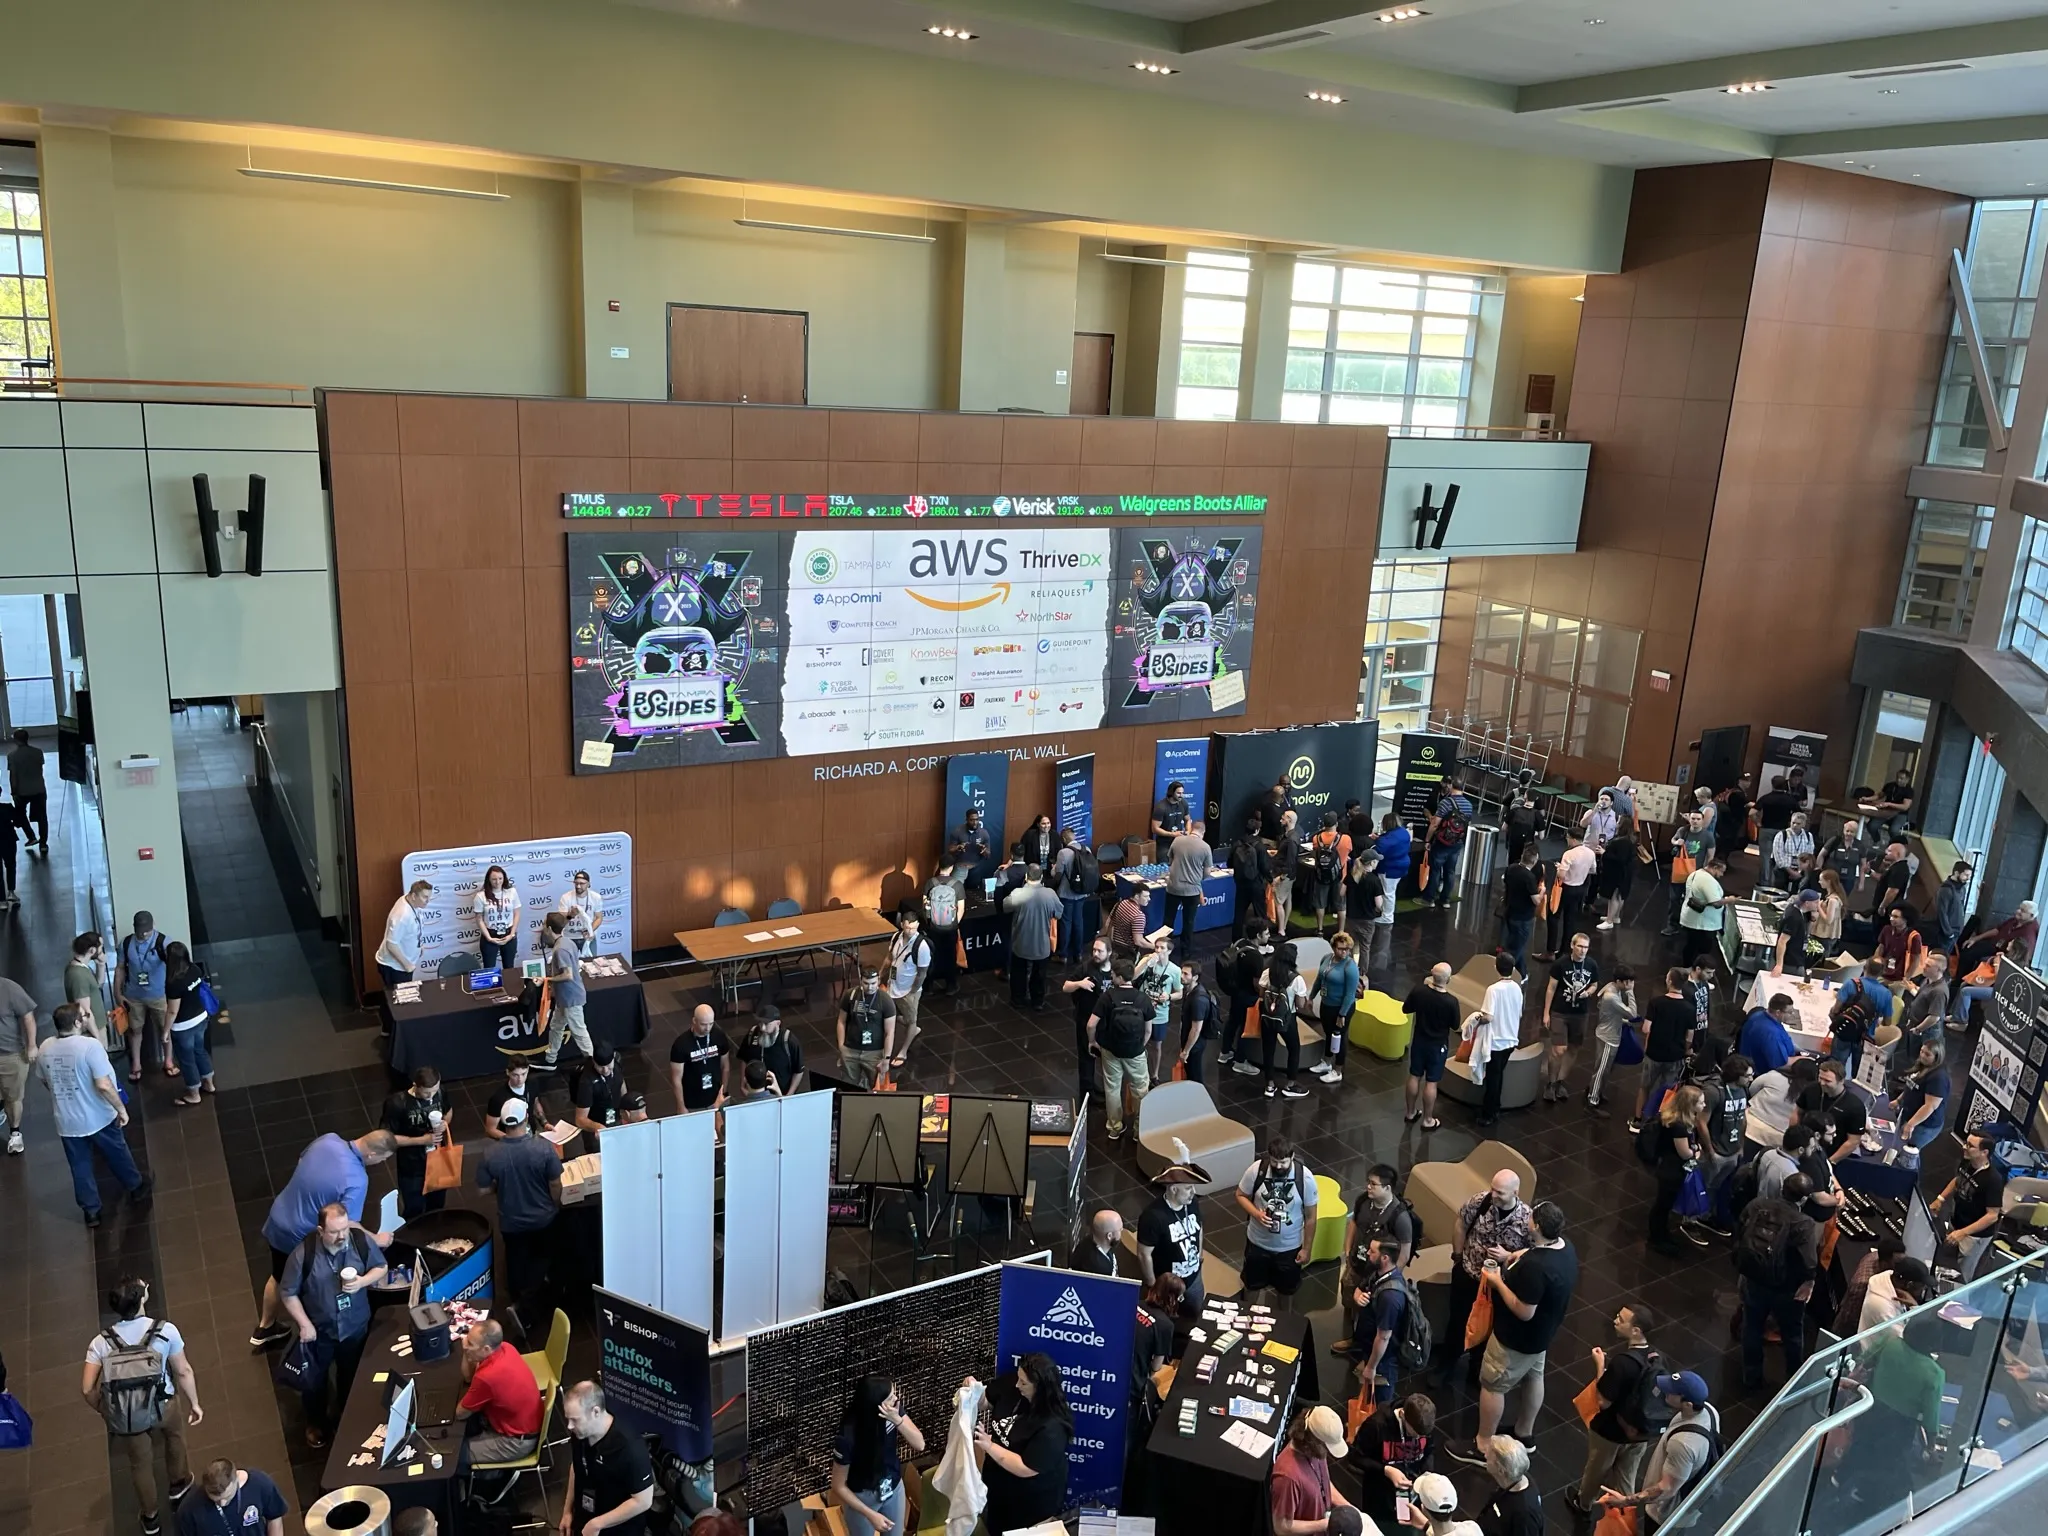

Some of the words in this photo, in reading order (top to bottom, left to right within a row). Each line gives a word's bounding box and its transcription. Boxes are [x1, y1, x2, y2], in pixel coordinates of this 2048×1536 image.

[571, 494, 605, 505] TMUS
[687, 495, 828, 517] TESLA
[829, 496, 854, 506] TSLA
[929, 496, 949, 506] TXN
[1012, 496, 1056, 516] Verisk
[1057, 496, 1080, 506] VRSK
[1120, 495, 1191, 513] Walgreens
[1193, 495, 1232, 512] Boots
[572, 506, 612, 517] 144.84
[627, 506, 652, 517] 0.27
[829, 506, 862, 517] 207.46
[876, 506, 902, 517] 12.18
[929, 506, 960, 517] 186.01
[972, 506, 991, 517] 1.77
[1057, 506, 1085, 516] 191.86
[1096, 506, 1113, 516] 0.90
[844, 561, 873, 570] TAMPA
[876, 560, 892, 570] BAY
[910, 538, 1008, 578] aws
[1020, 550, 1102, 569] ThriveDX
[825, 592, 882, 606] AppOmni
[1031, 588, 1086, 598] RELIAQUEST
[663, 592, 687, 622] X
[1030, 612, 1073, 622] NorthStar
[1052, 639, 1092, 648] GUIDEPOINT
[911, 647, 958, 659] KnowBe4
[1175, 653, 1209, 661] TAMPA
[669, 690, 717, 698] TAMPA
[831, 685, 858, 693] FLORIDA
[807, 710, 836, 718] abacode
[879, 731, 899, 740] SOUTH
[900, 729, 925, 738] FLORIDA
[1170, 749, 1201, 758] AppOmni
[814, 761, 885, 780] RICHARD
[887, 760, 901, 774] A.
[1034, 744, 1069, 758] WALL
[1291, 791, 1330, 806] nology
[413, 862, 438, 872] aws
[452, 858, 477, 868] aws
[490, 854, 514, 864] aws
[527, 850, 551, 860] aws
[563, 846, 586, 855] aws
[599, 841, 622, 851] aws
[454, 881, 478, 892] aws
[528, 872, 551, 883] aws
[599, 864, 622, 874] aws
[456, 906, 474, 916] aw
[529, 895, 552, 906] aws
[600, 886, 622, 896] aws
[457, 928, 481, 940] aws
[600, 930, 623, 940] aws
[1994, 991, 2008, 1008] TECH
[2008, 1003, 2033, 1027] SUCCESS
[2000, 1011, 2020, 1030] NETWORK
[456, 1269, 491, 1300] ERADE
[624, 1321, 677, 1349] BISHOPFOX
[1028, 1323, 1105, 1347] abacode
[604, 1339, 653, 1370] Outfox
[604, 1355, 678, 1395] attackers.
[1056, 1363, 1098, 1380] eader
[1101, 1369, 1116, 1383] in
[604, 1371, 637, 1391] Continuous
[638, 1387, 666, 1403] offensive
[666, 1399, 693, 1413] security
[1061, 1382, 1091, 1396] fied
[604, 1380, 631, 1396] solutions
[631, 1392, 659, 1408] designed
[667, 1408, 691, 1420] protect
[615, 1393, 630, 1404] most
[631, 1399, 657, 1415] dynamic
